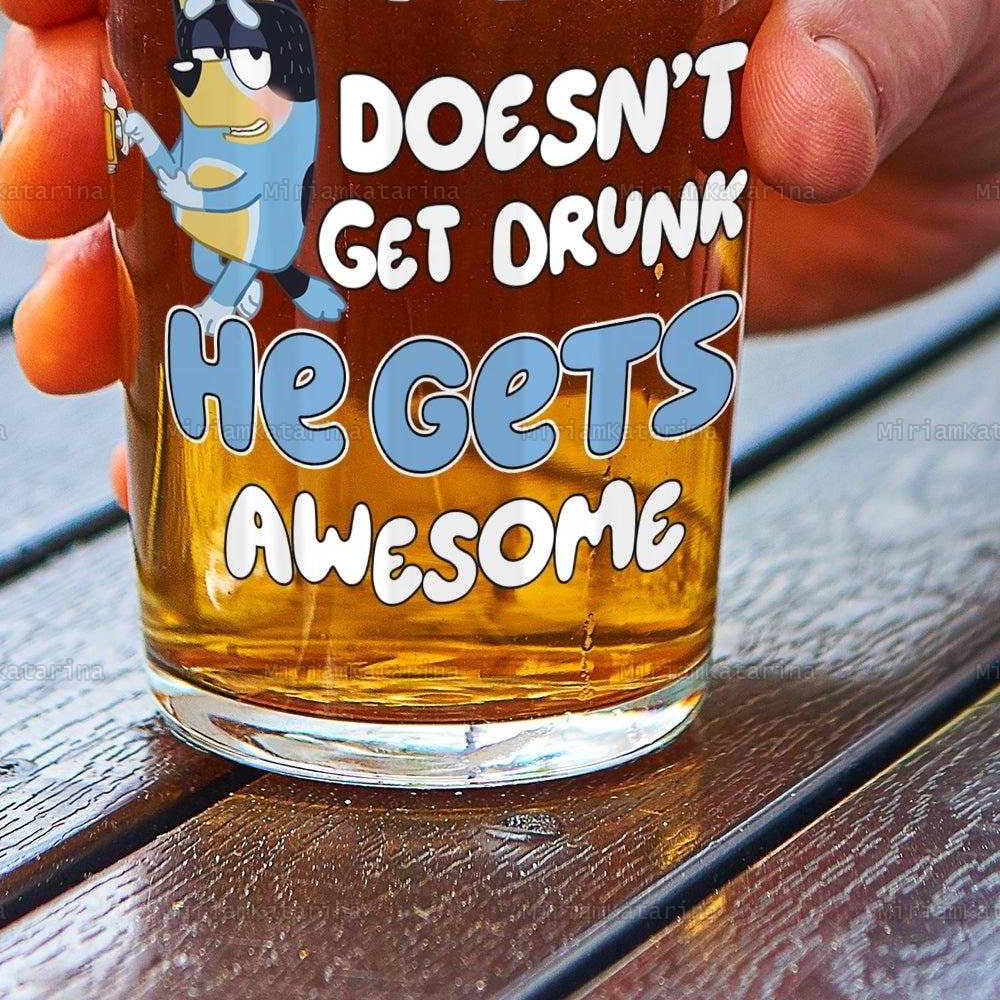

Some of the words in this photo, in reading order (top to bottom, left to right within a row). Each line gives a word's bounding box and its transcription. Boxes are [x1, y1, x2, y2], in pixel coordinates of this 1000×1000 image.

[339, 40, 749, 173] DOESN'T
[318, 199, 461, 290] GET
[491, 168, 749, 288] DRUNK
[223, 477, 687, 606] AWESOME
